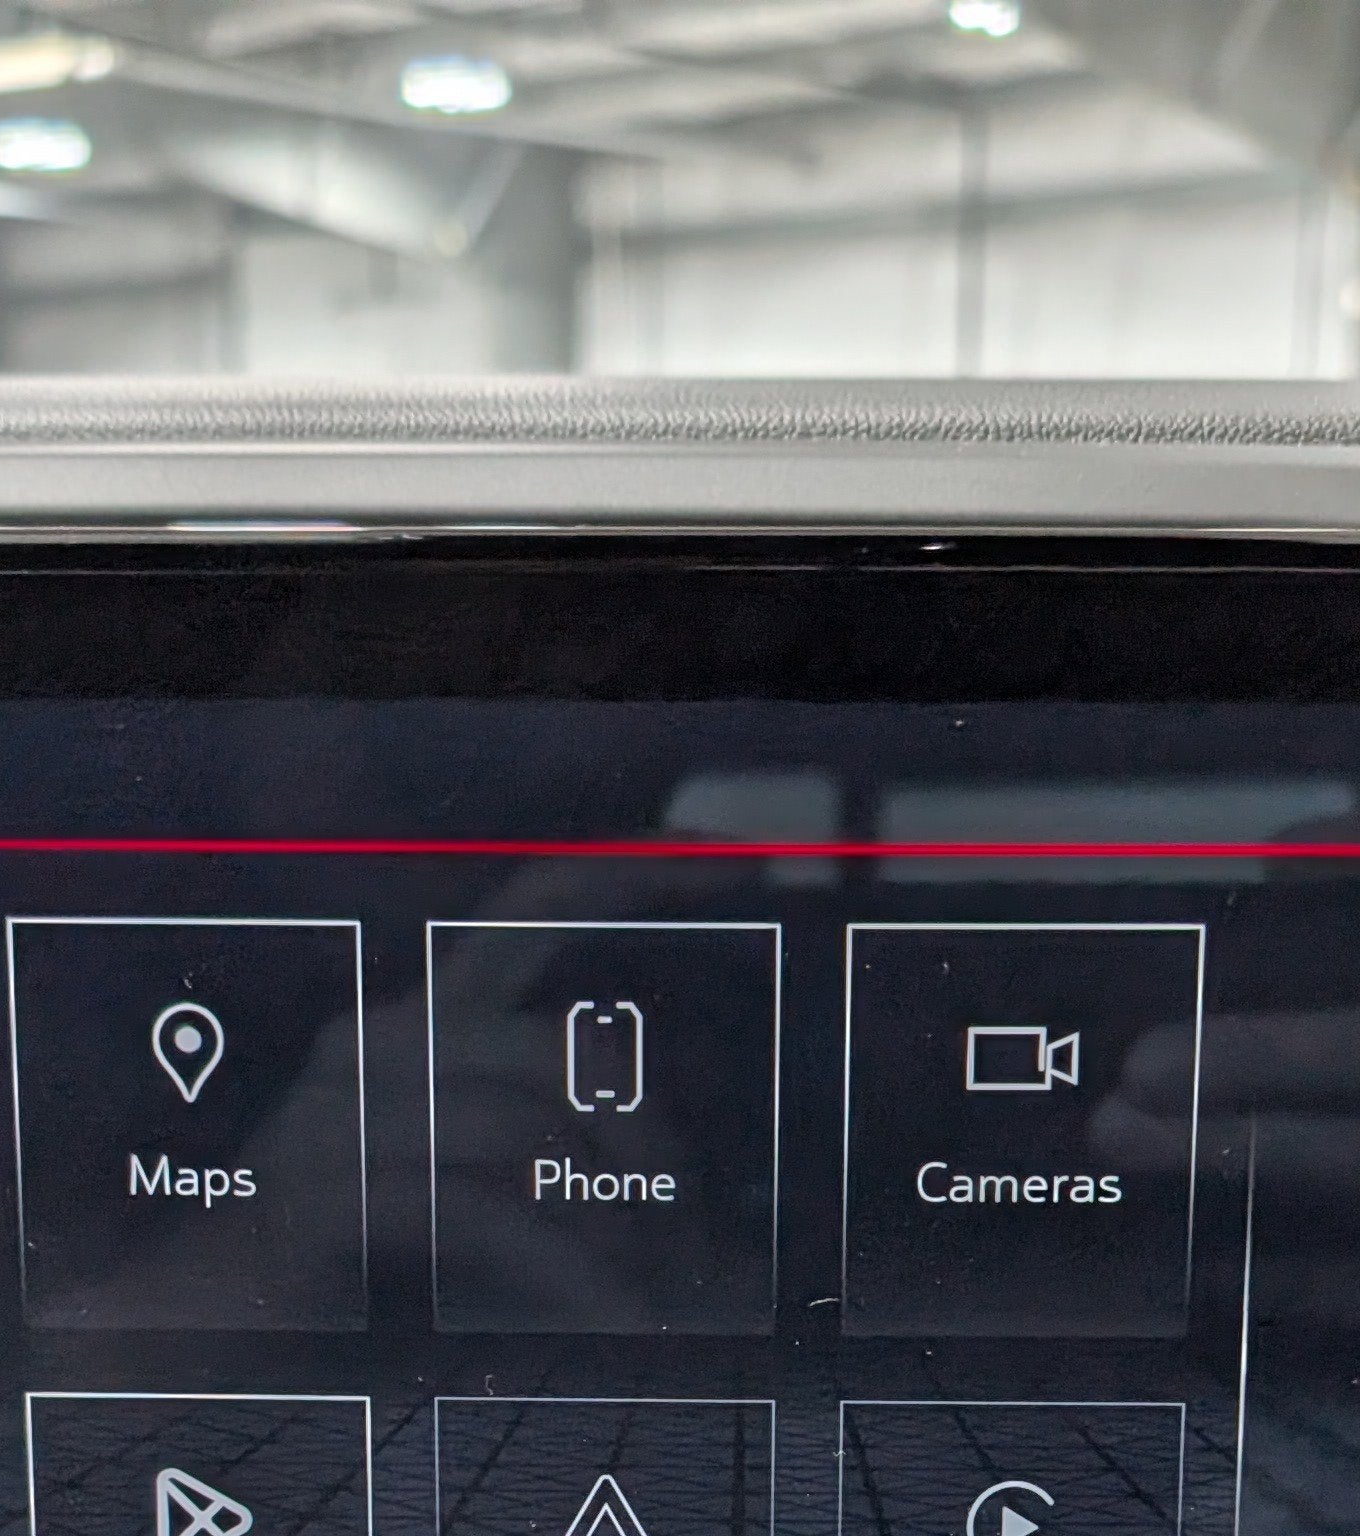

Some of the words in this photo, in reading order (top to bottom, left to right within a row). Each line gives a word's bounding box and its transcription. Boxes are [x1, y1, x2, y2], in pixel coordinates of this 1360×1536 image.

[128, 1153, 258, 1209] Maps
[534, 1157, 677, 1202] Phone
[916, 1161, 1123, 1204] Cameras
